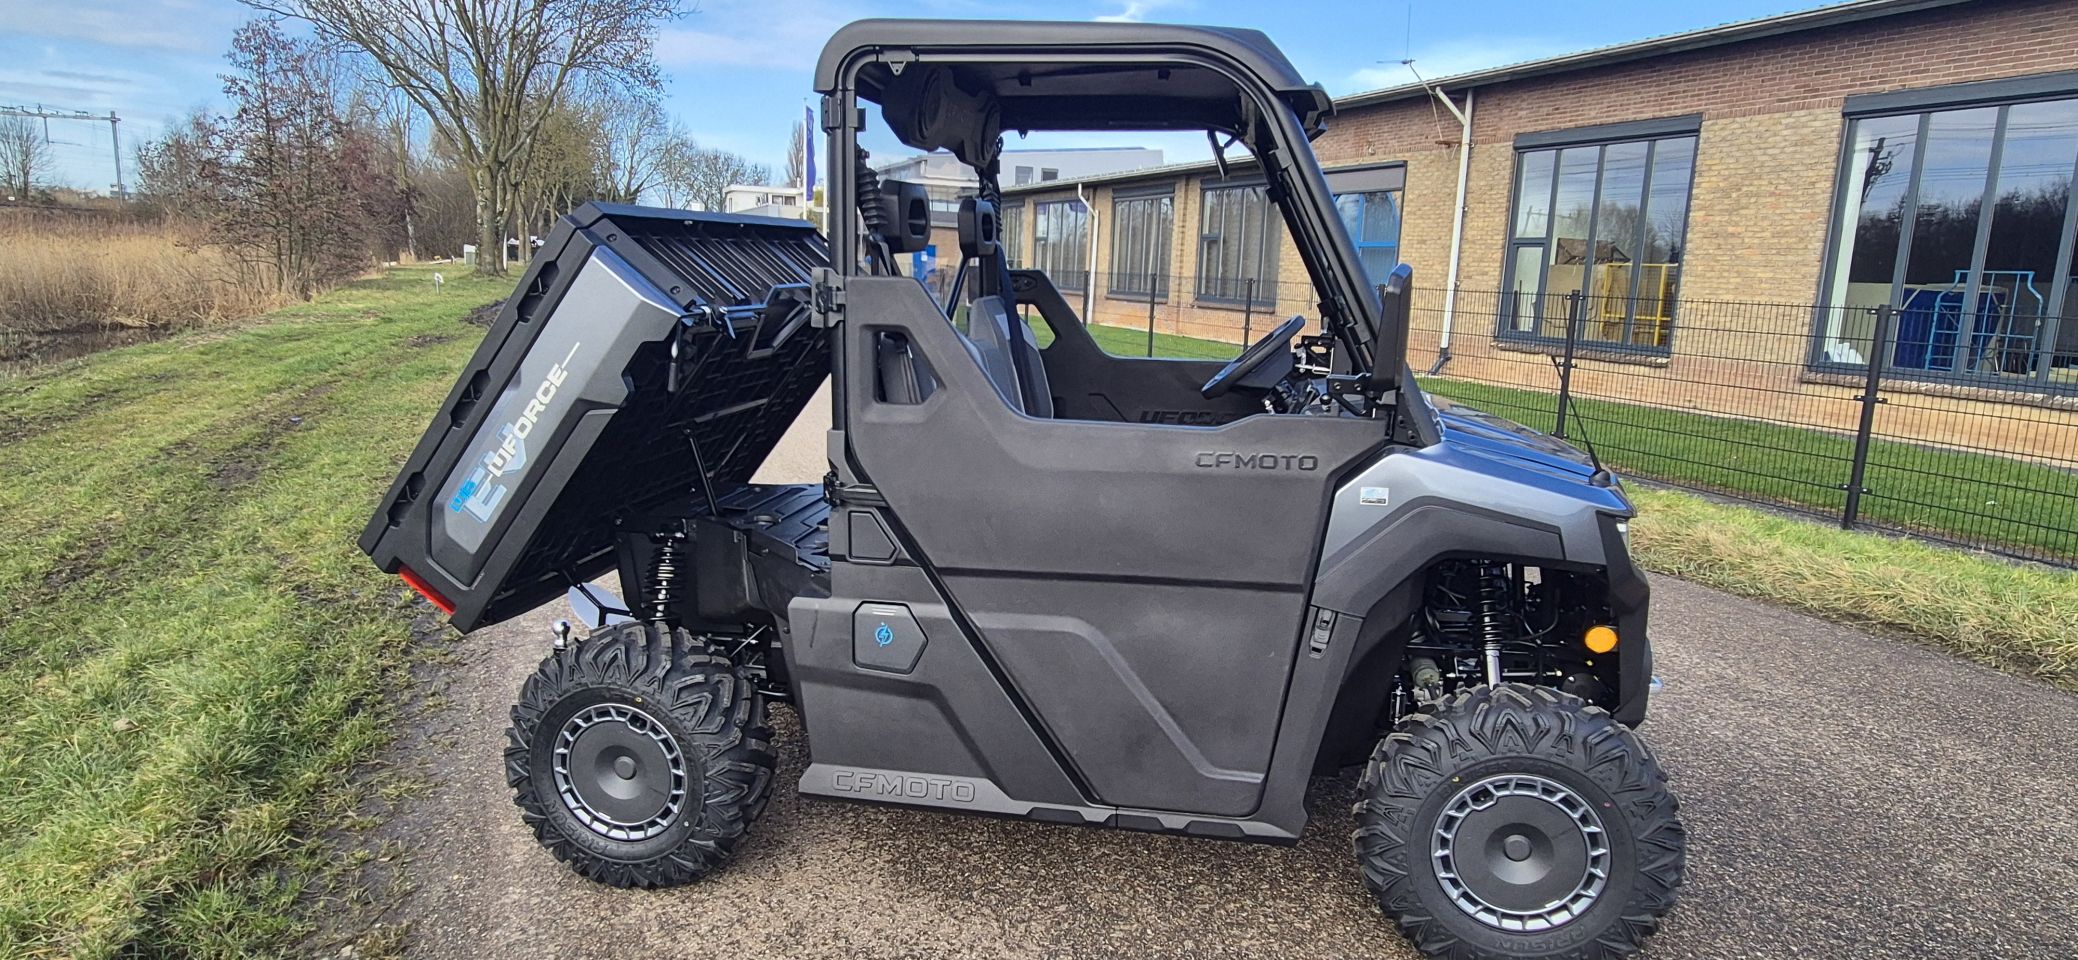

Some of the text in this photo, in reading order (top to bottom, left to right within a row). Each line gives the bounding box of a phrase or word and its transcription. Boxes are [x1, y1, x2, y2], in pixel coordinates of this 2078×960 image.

[488, 363, 568, 477] UFORCE
[1195, 451, 1318, 471] CFMOTO
[832, 771, 976, 802] CFMOTO
